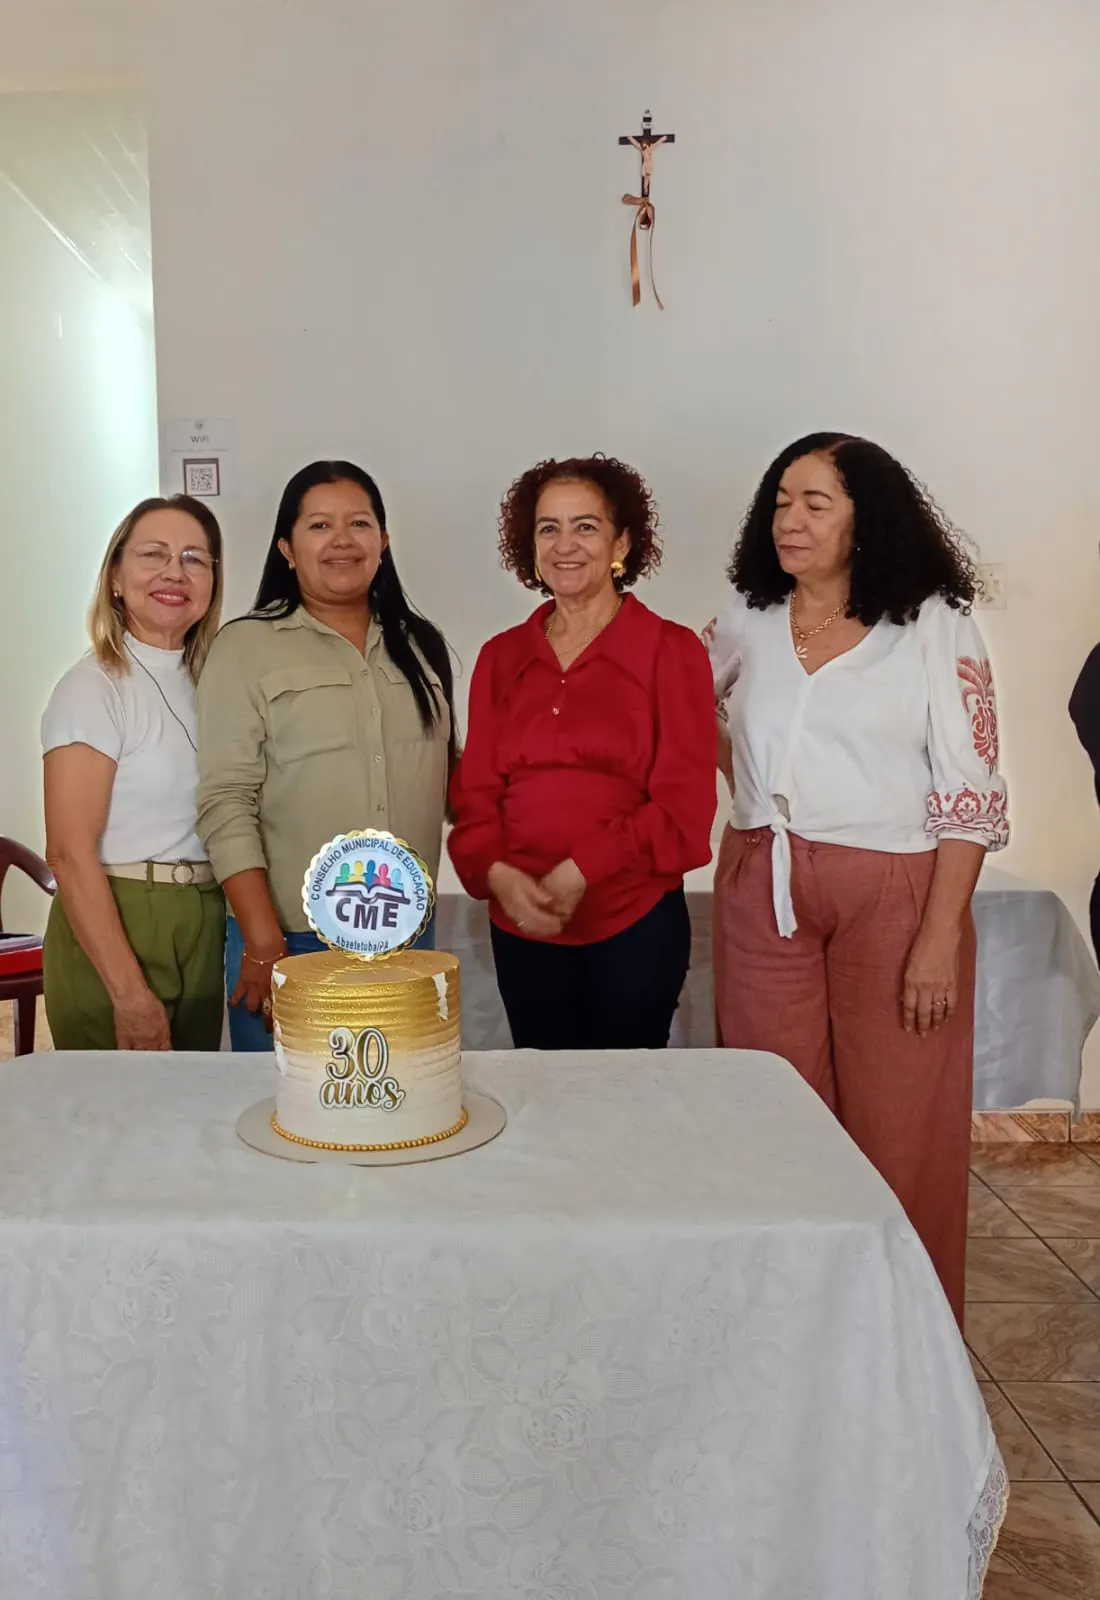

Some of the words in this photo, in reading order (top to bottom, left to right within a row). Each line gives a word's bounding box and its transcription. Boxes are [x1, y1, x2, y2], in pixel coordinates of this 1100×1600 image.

[311, 850, 342, 901] CONSELHO
[341, 838, 391, 854] MUNICIPAL
[391, 847, 405, 860] DE
[401, 856, 425, 911] EDUCAÇÃO
[335, 897, 399, 931] CME
[326, 1026, 389, 1081] 30
[320, 1077, 406, 1112] anos
